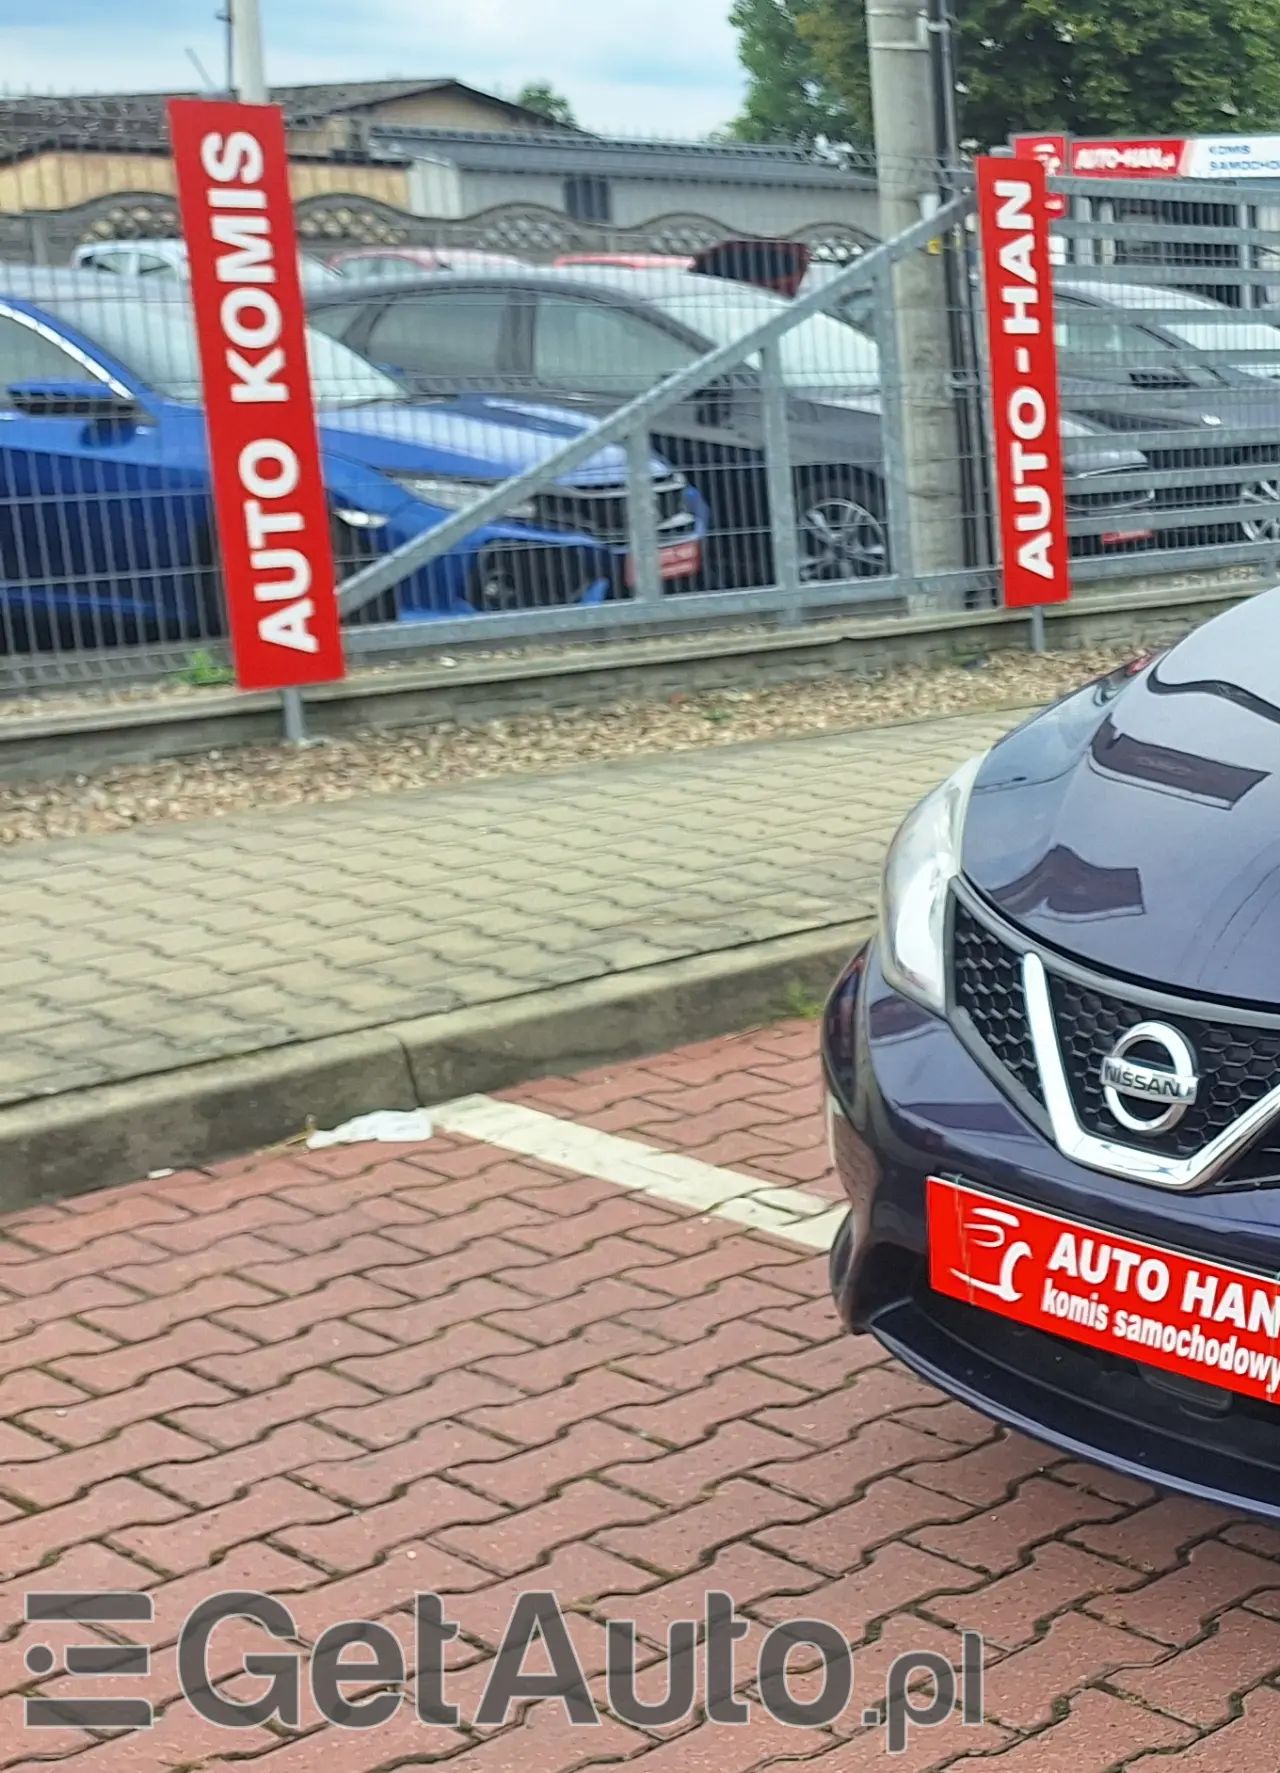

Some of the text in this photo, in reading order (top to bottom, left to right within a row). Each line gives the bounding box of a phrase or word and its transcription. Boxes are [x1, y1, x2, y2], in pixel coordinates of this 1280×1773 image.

[201, 131, 319, 654] AUTO KOMIS
[1104, 1063, 1181, 1097] NISSAN
[1048, 1233, 1170, 1302] AUTO
[1041, 1278, 1109, 1332] komis
